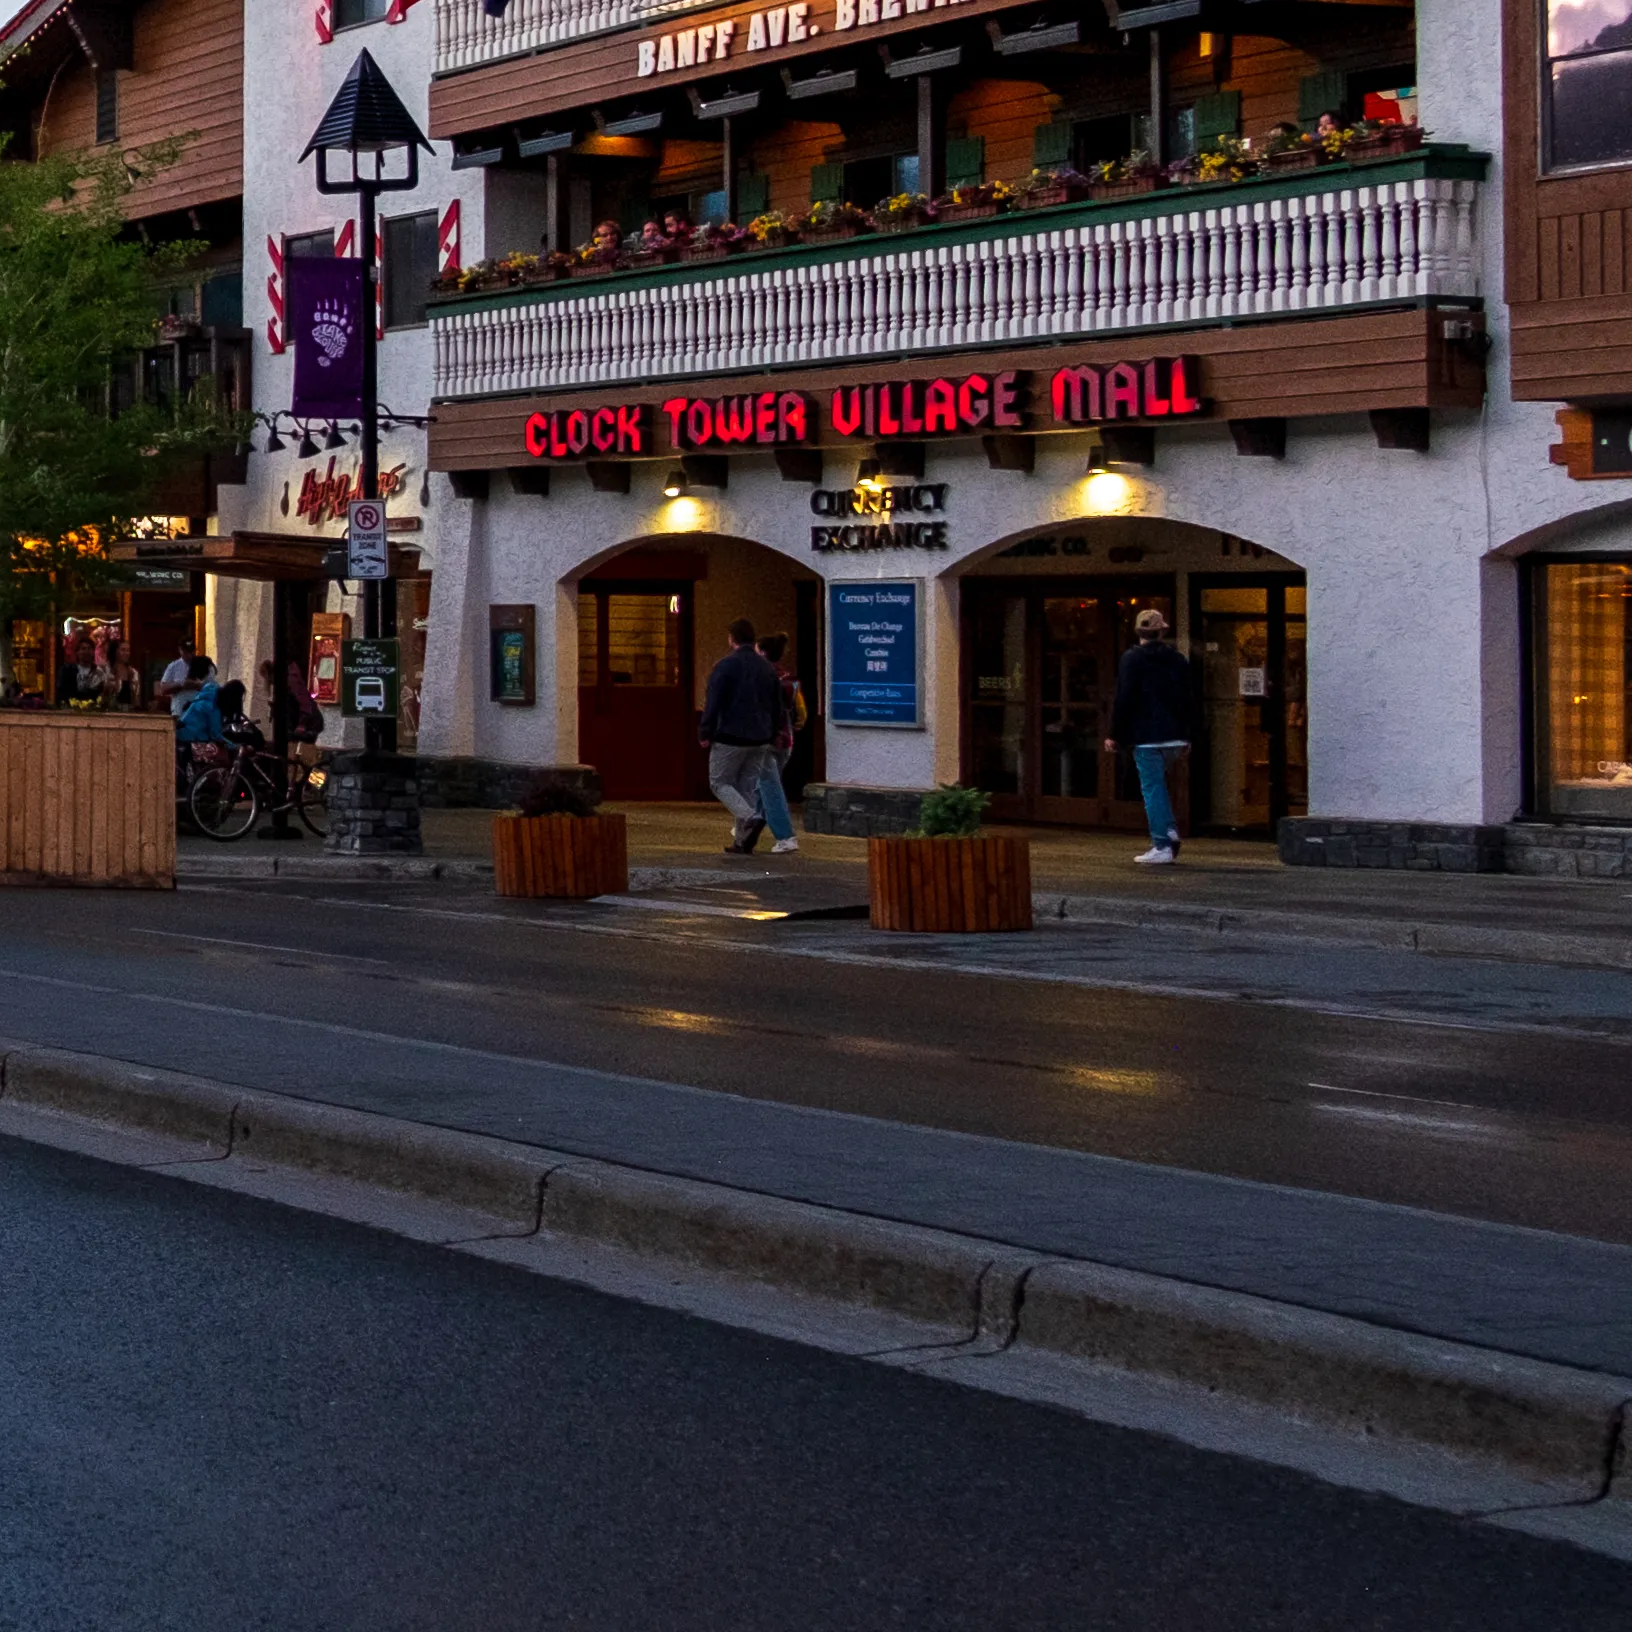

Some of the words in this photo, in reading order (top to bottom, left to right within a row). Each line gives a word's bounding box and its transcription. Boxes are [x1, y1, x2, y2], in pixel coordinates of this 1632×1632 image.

[637, 19, 734, 77] BANFF
[747, 2, 820, 52] AVE.
[524, 406, 642, 457] CLOCK
[662, 391, 808, 449] TOWER
[831, 370, 1020, 437] VILLAGE
[1052, 355, 1201, 421] MALL
[811, 521, 948, 552] EXCHANGE
[839, 592, 874, 606] Currency
[876, 592, 911, 606] Exchange
